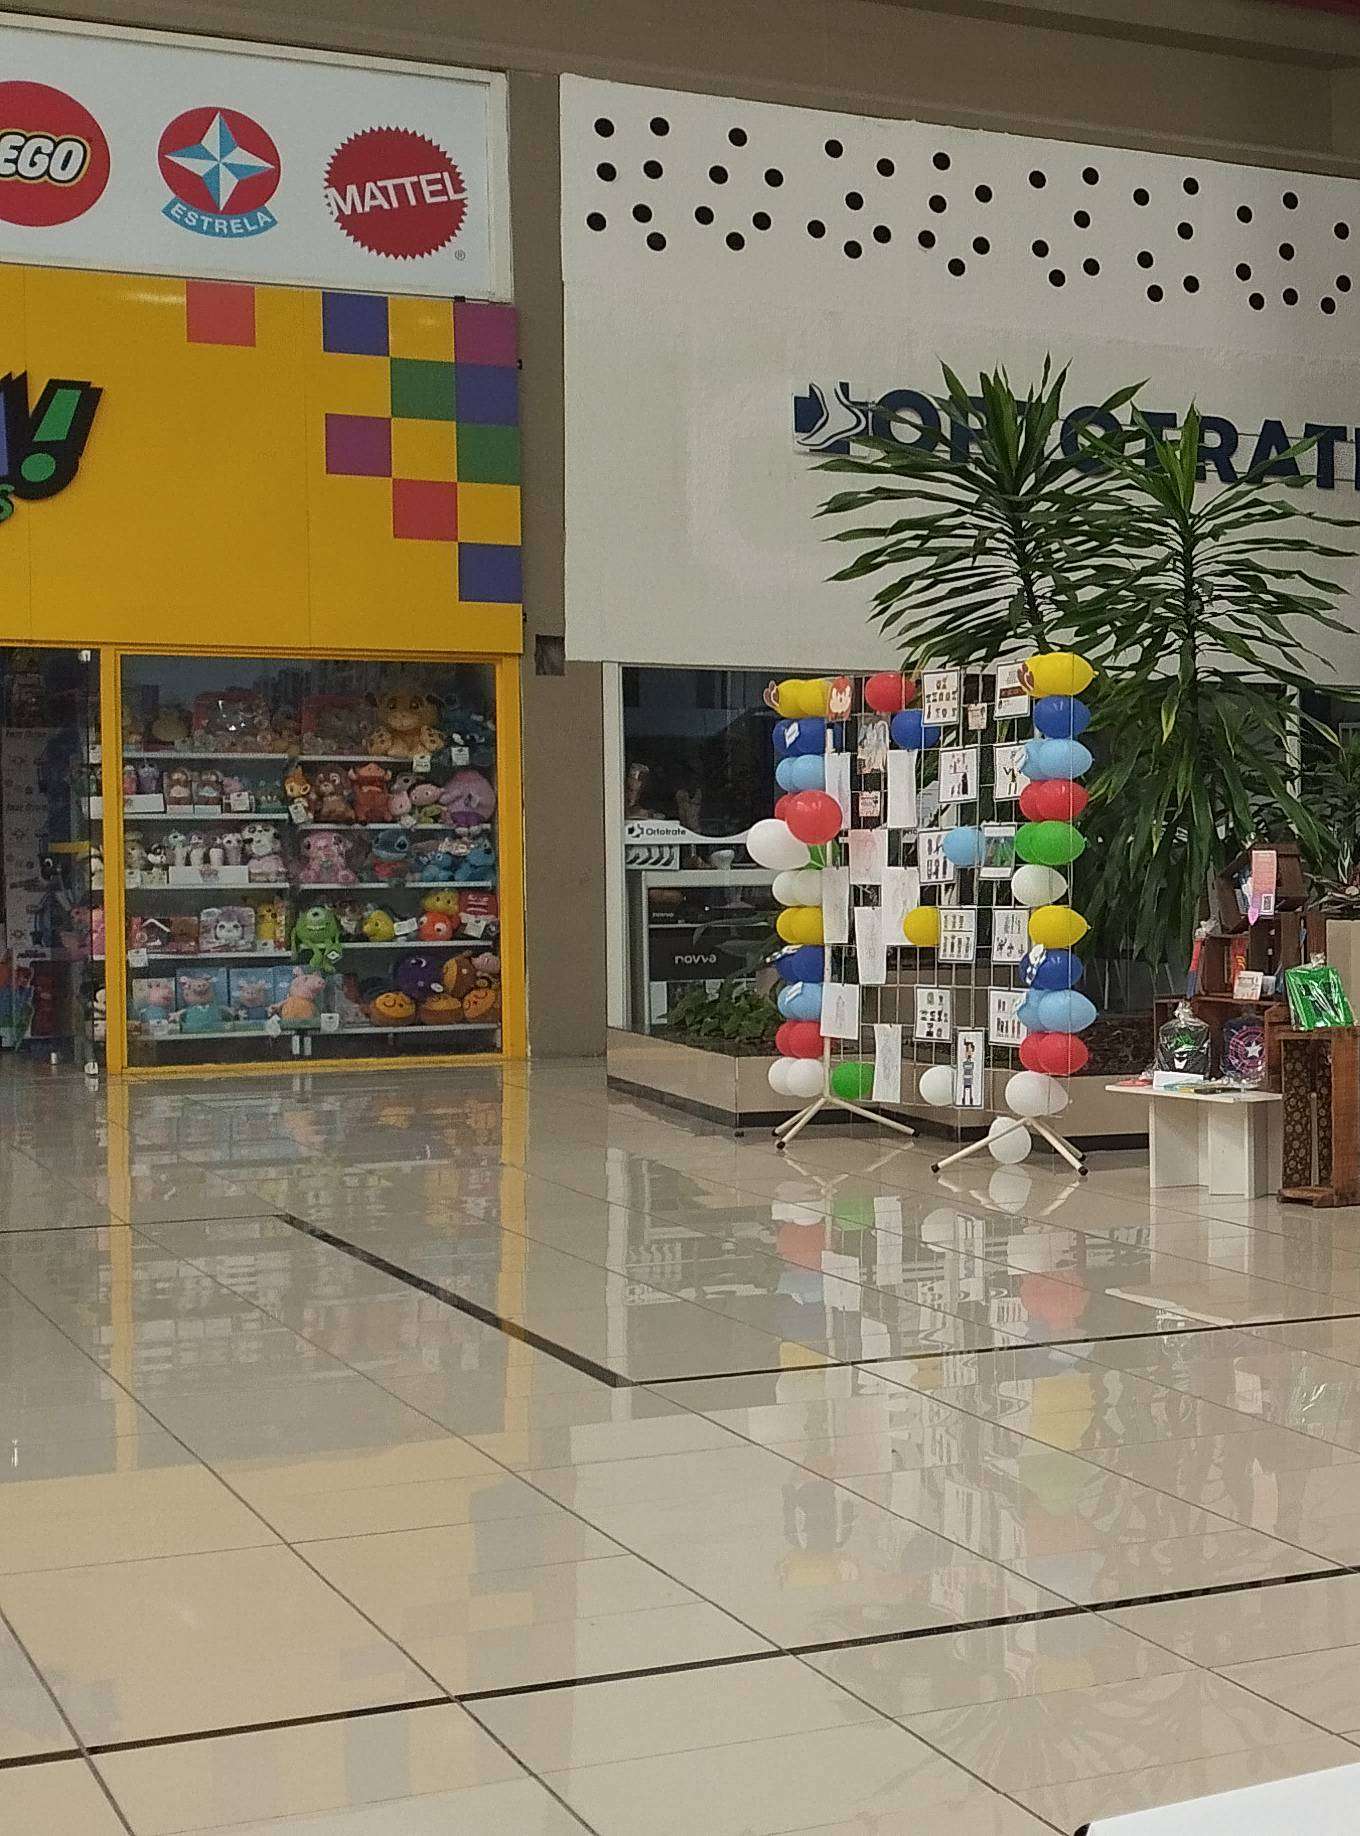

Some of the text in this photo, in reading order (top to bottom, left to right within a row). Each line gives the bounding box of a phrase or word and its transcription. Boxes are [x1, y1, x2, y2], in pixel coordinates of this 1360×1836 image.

[0, 134, 85, 181] EGO
[329, 171, 467, 217] MATTEL
[171, 204, 272, 236] ESTRELA
